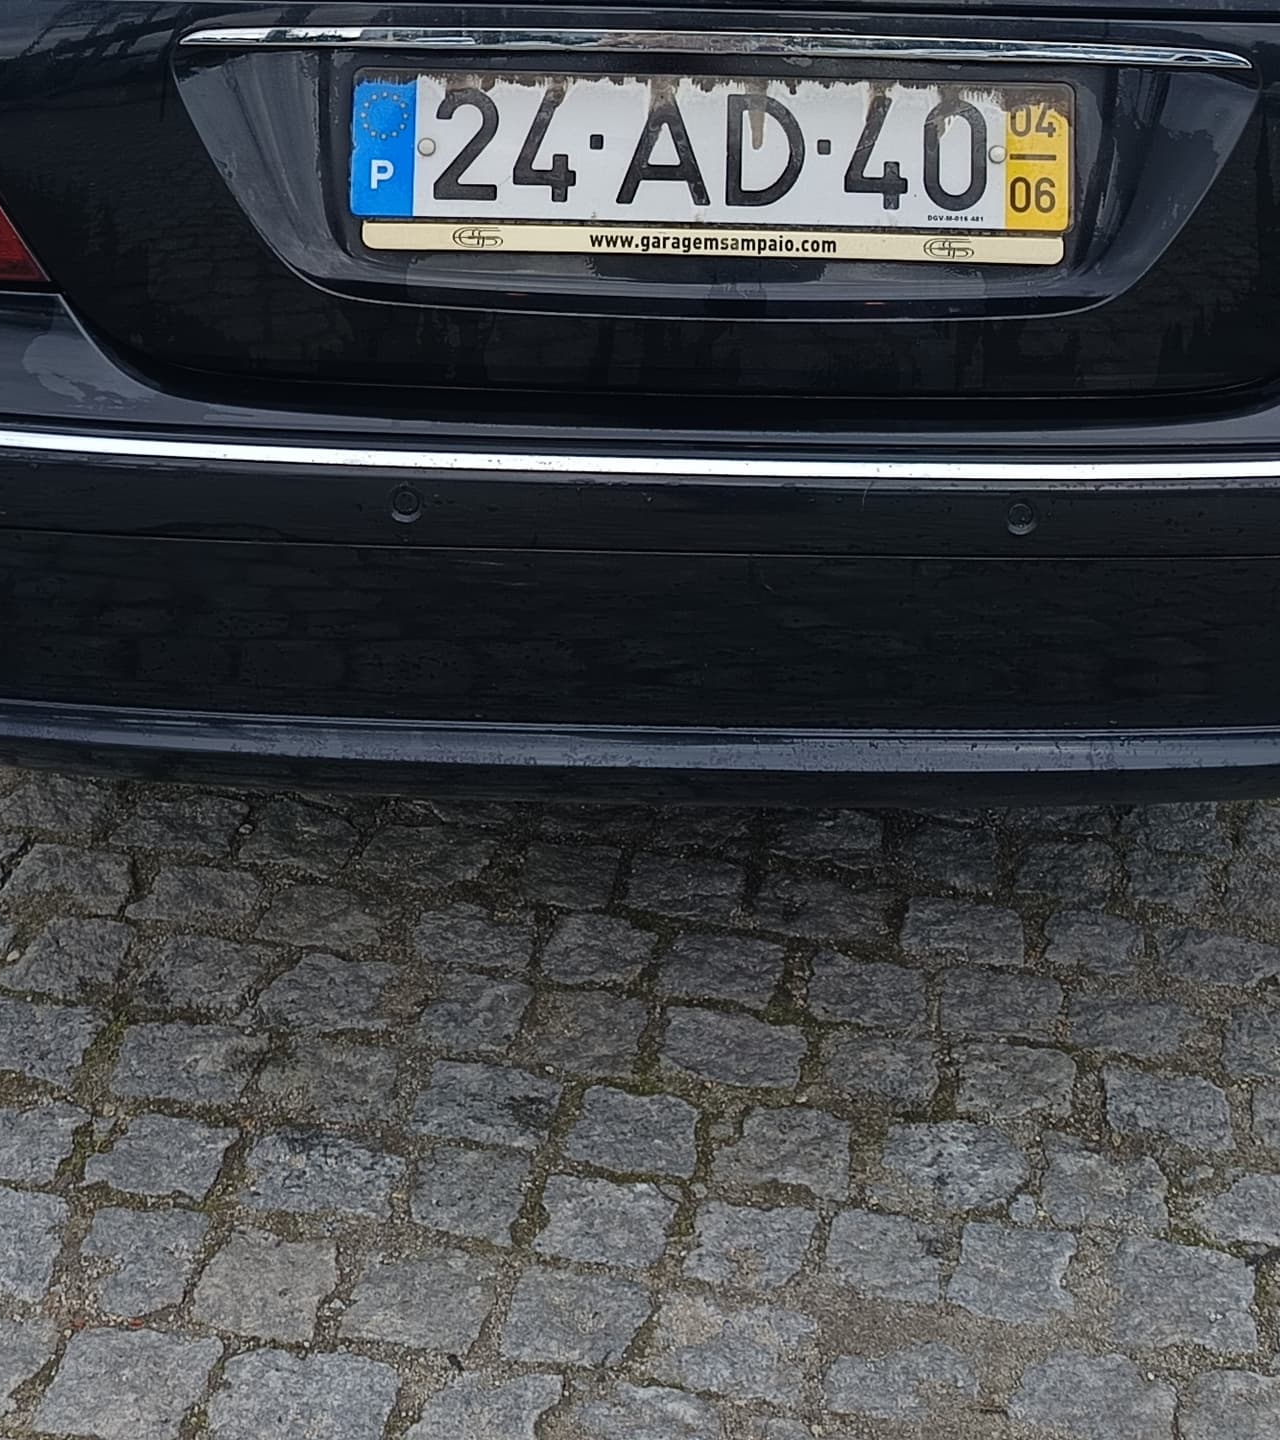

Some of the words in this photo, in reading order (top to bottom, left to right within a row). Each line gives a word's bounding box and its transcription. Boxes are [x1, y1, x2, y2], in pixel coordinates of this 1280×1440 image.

[1009, 103, 1056, 138] 04
[370, 159, 394, 190] P
[1009, 176, 1056, 214] 06
[589, 234, 837, 254] www.garagemsampaio.com
